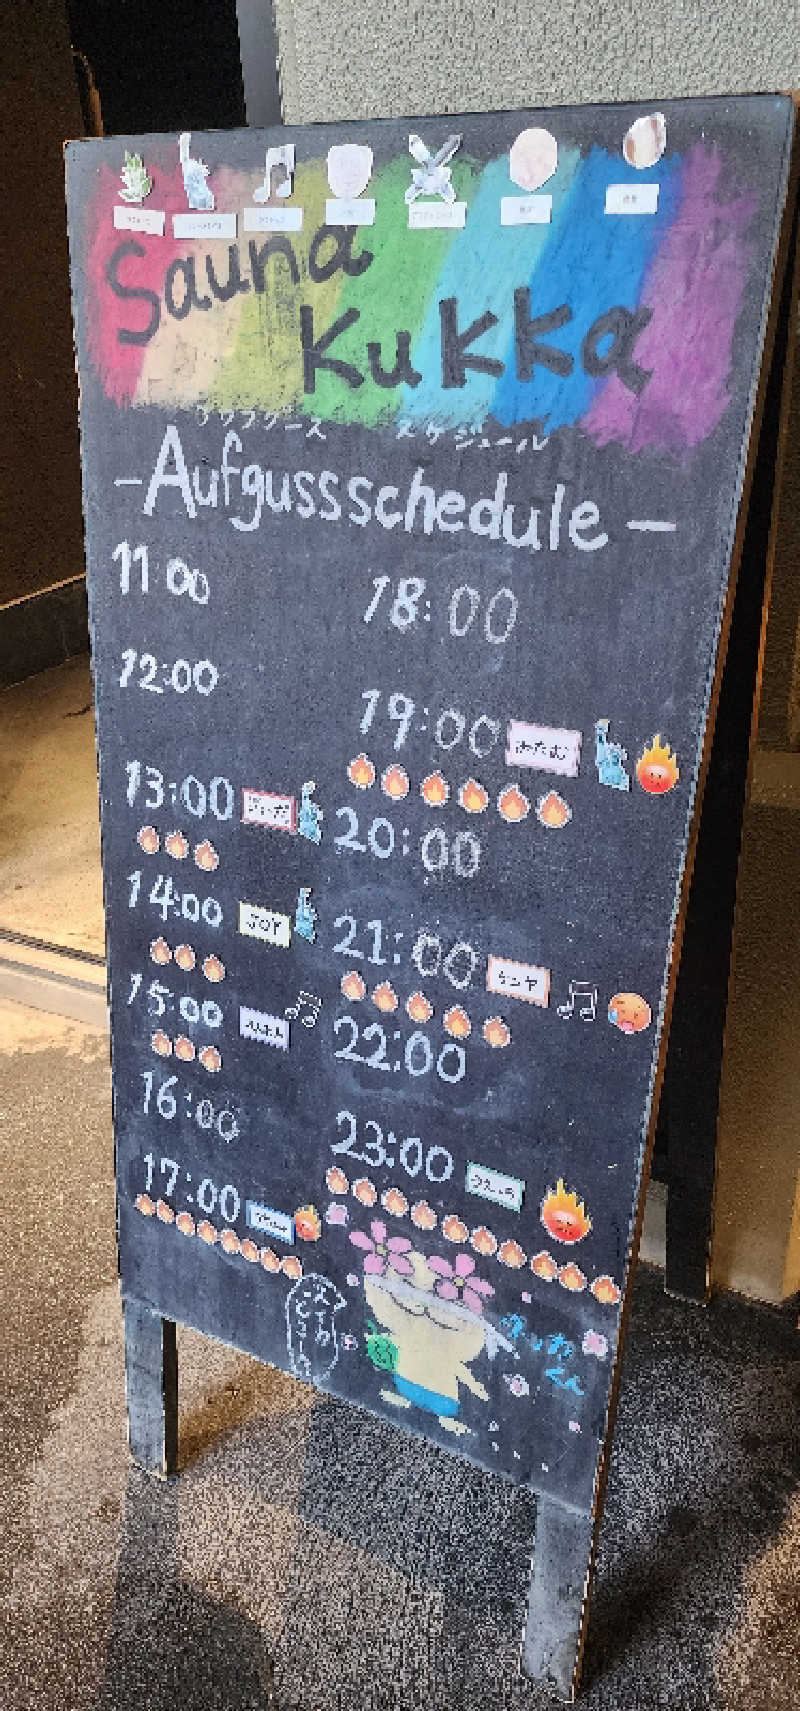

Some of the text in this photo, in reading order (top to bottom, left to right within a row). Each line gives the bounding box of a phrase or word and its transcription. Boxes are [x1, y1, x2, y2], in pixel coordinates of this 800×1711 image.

[105, 224, 374, 347] Sauna
[363, 575, 518, 644] 18:00
[119, 649, 219, 696] 12:00
[359, 688, 500, 759] 19:00
[125, 760, 234, 820] 13:00
[334, 806, 480, 878] 20:00
[127, 870, 223, 928] 14:00
[331, 914, 478, 989] 21:00
[127, 973, 223, 1027] 15:00
[333, 1015, 466, 1084] 22:00
[140, 1071, 241, 1143] 16:00
[330, 1110, 453, 1183] 23:00
[143, 1152, 240, 1222] 17:00
